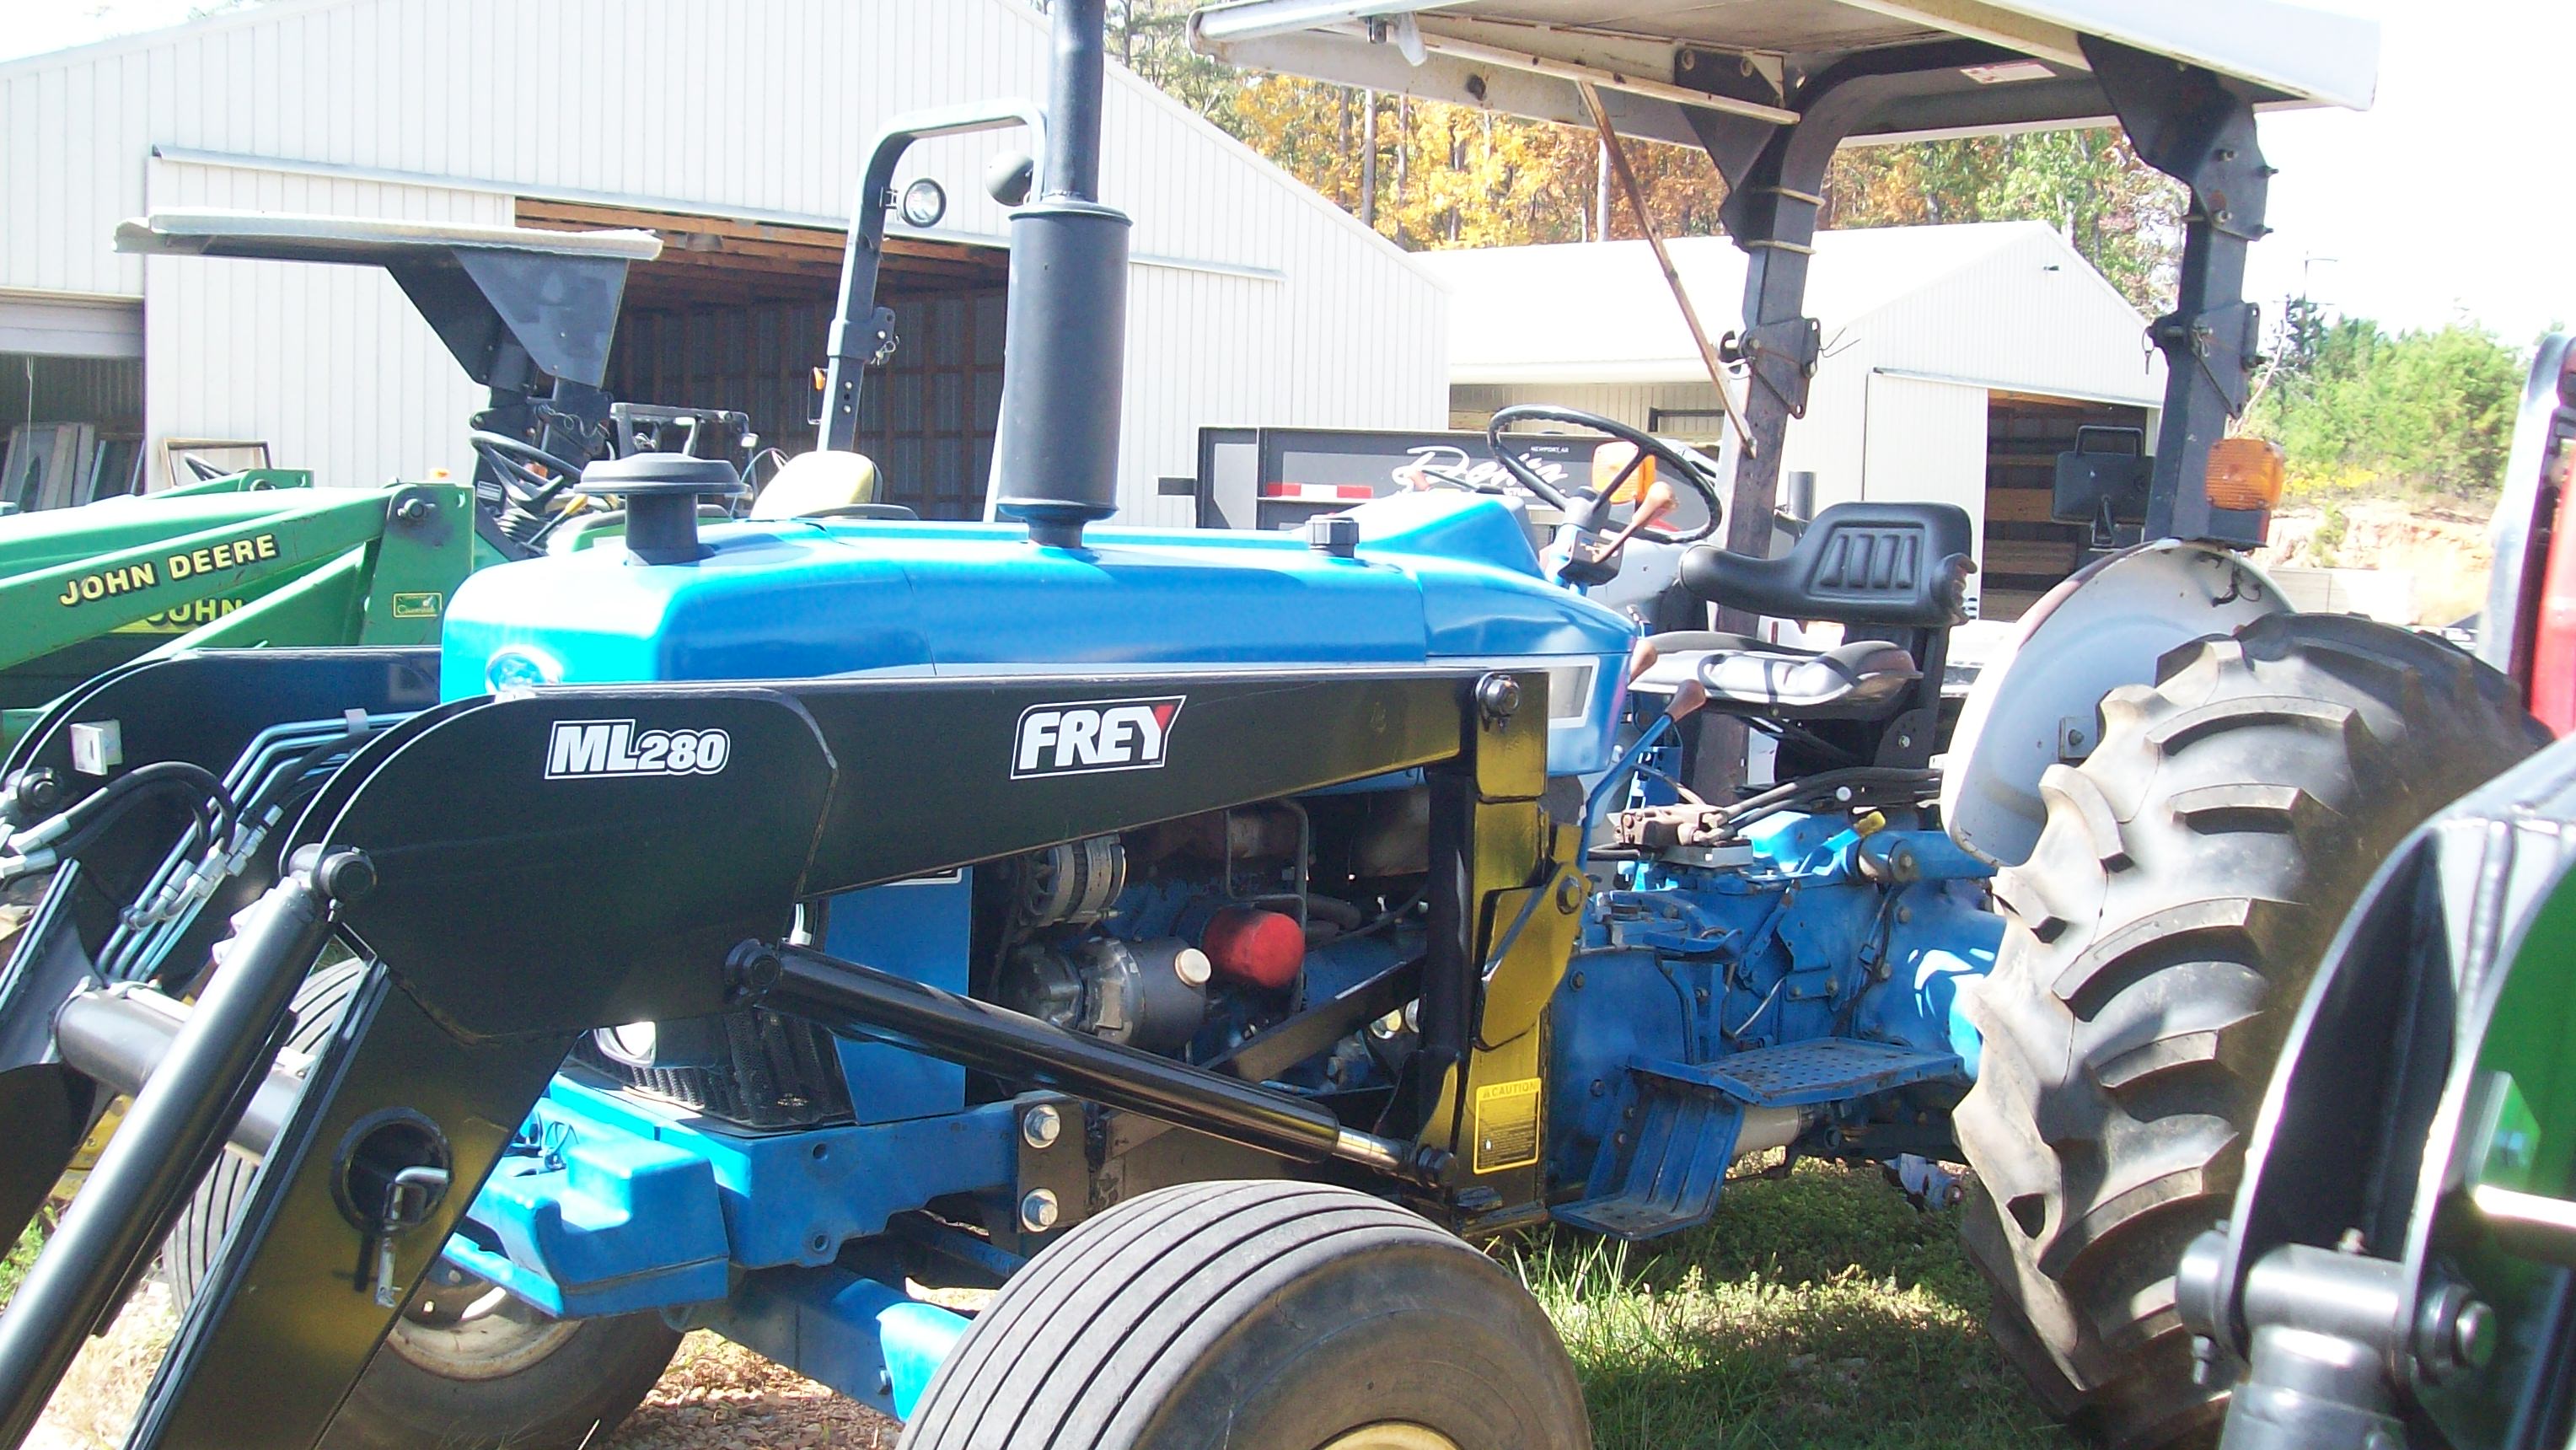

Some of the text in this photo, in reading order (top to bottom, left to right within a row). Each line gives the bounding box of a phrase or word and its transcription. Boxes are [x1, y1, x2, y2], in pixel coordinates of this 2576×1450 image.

[60, 534, 276, 605] JOHN DEERE
[148, 599, 243, 622] OHN
[550, 724, 727, 773] ML280
[1018, 705, 1173, 771] FREY
[1491, 1082, 1536, 1096] CAUTION
